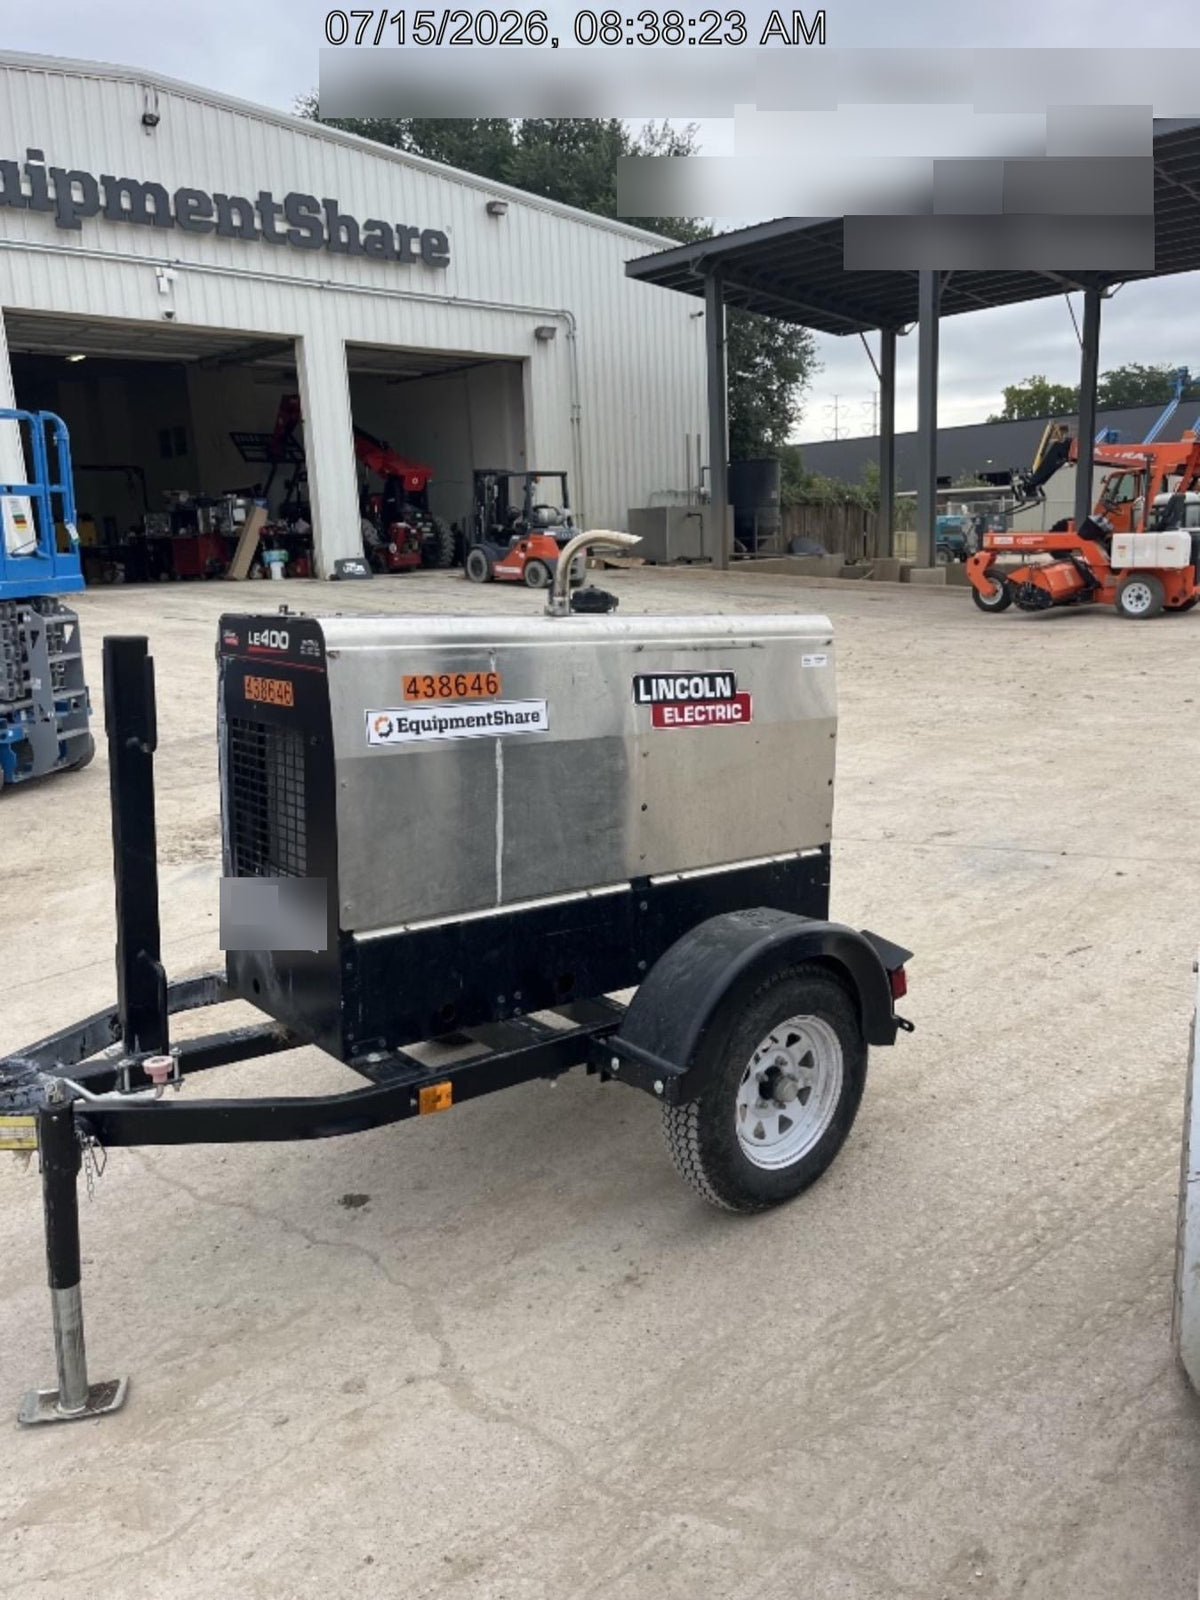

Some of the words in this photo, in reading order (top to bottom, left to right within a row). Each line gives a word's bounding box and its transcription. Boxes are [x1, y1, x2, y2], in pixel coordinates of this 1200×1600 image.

[248, 629, 289, 650] LE400
[246, 677, 292, 705] 438646
[406, 672, 499, 698] 438646
[639, 676, 732, 702] LINCOLN
[396, 710, 541, 735] EquipmentShare
[663, 703, 742, 724] ELECTRIC
